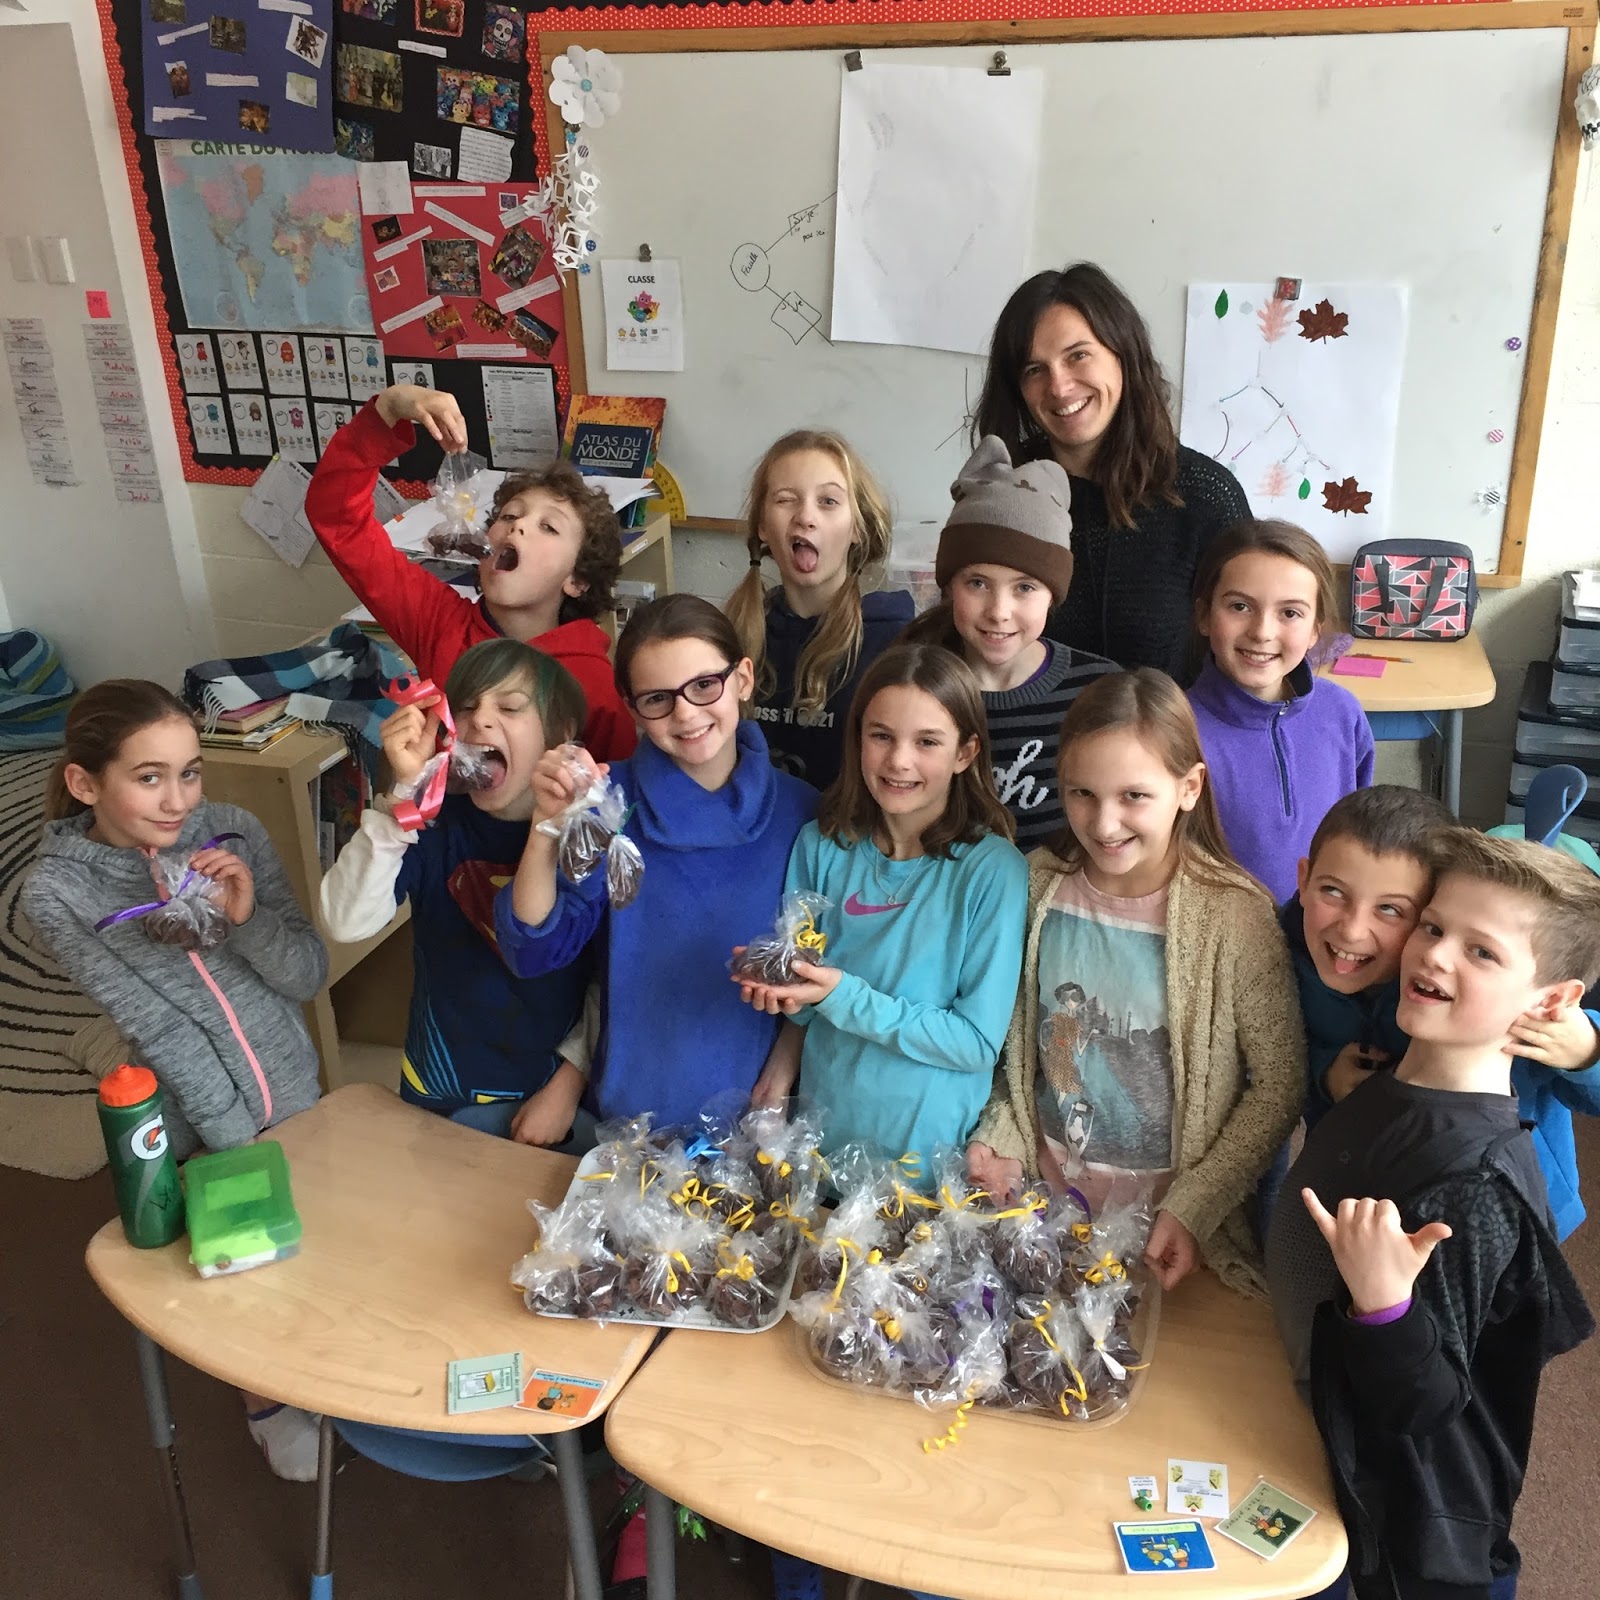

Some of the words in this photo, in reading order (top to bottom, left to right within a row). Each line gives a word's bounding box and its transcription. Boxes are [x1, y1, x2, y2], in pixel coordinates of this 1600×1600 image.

[191, 141, 247, 155] CARTE
[627, 275, 656, 284] CLASSE
[581, 434, 619, 447] ATLAS
[623, 437, 642, 448] DU
[576, 444, 641, 461] MONDE
[131, 1113, 168, 1160] G
